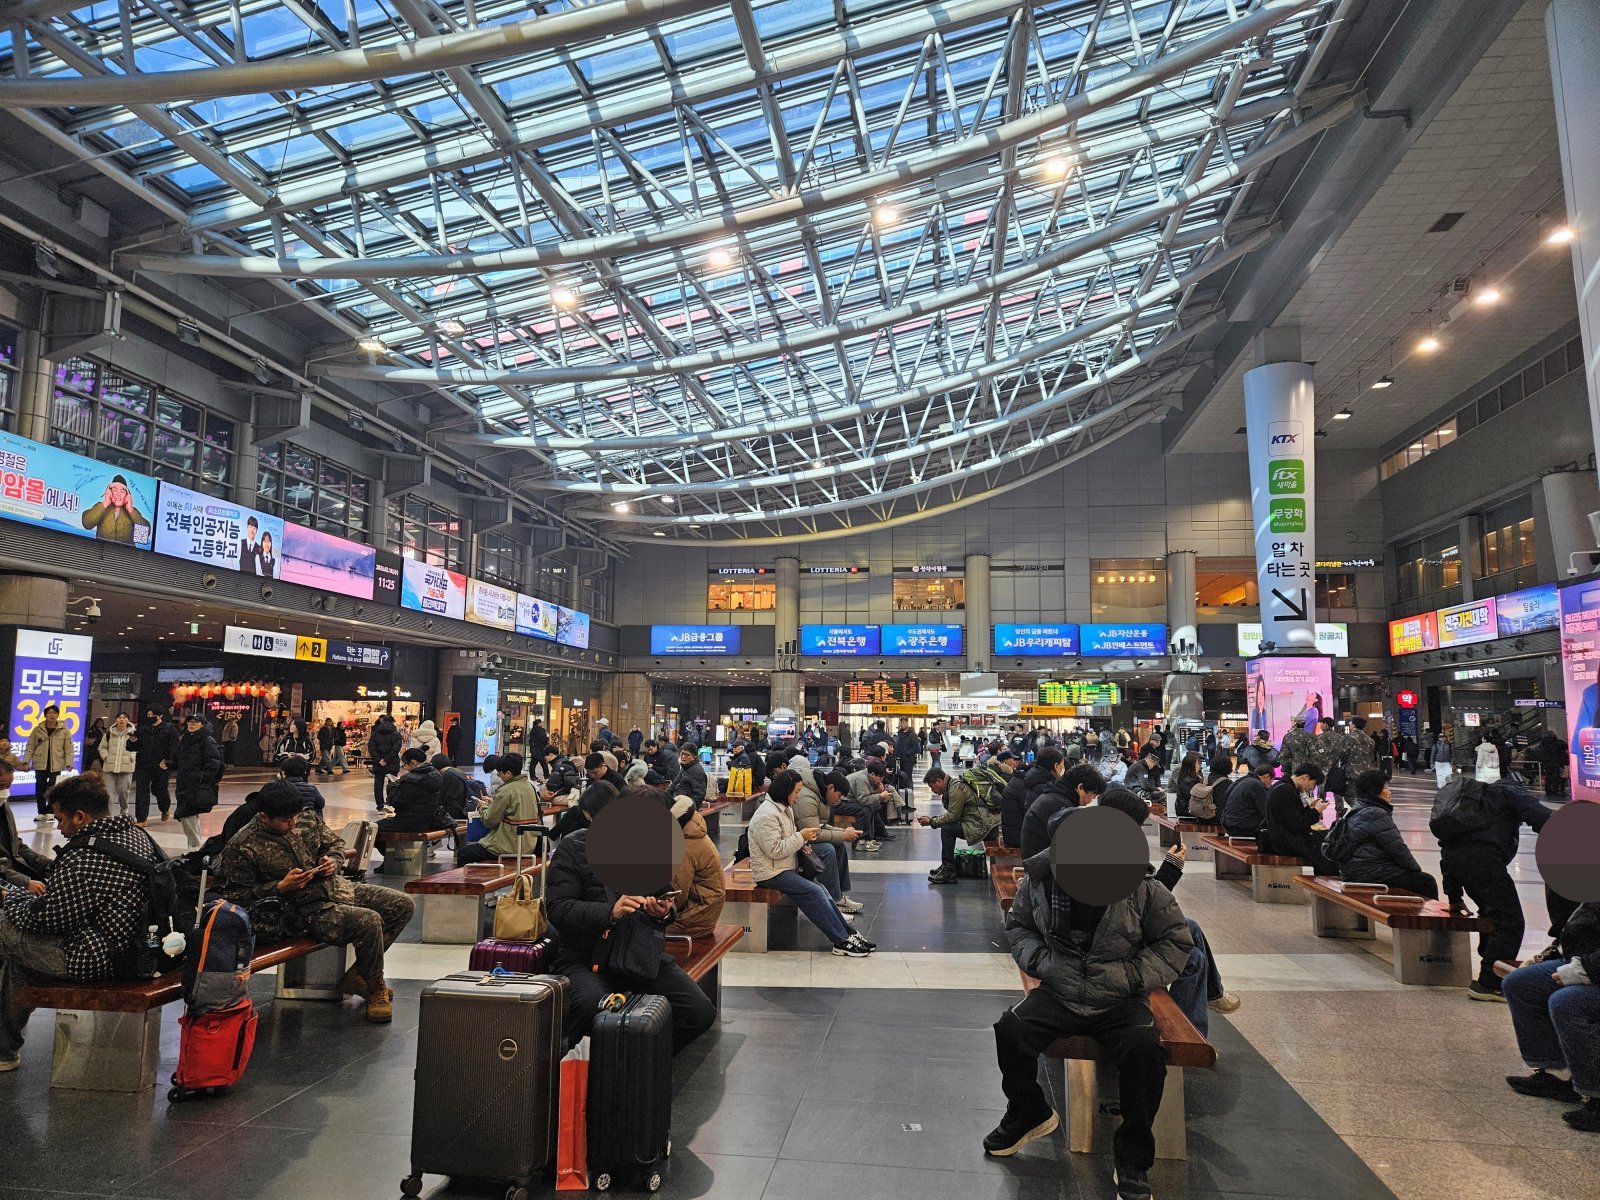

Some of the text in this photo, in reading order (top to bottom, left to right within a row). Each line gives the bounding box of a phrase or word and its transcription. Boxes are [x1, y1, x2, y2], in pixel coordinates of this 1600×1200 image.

[1271, 433, 1301, 444] KTX
[1276, 480, 1297, 489] 새마을
[0, 469, 80, 512] 암몰에서!
[1273, 508, 1303, 519] 무궁화
[165, 512, 240, 540] 전북인공지능
[189, 538, 238, 559] 고등학교
[1268, 562, 1311, 578] 타는 곳
[1444, 607, 1489, 632] 전주기전대학
[678, 632, 723, 642] JB금융그룹
[1106, 629, 1148, 638] JB자산운용
[1318, 631, 1343, 641] 팔꿈치
[275, 638, 288, 648] 화장실
[827, 636, 866, 647] 전북은행
[907, 636, 947, 647] 광주은행
[1013, 637, 1071, 648] JB우리캐피탈
[1101, 640, 1155, 650] JB인베스트먼트
[313, 644, 320, 656] 2
[346, 646, 356, 656] 타는
[19, 669, 83, 697] 모두탑
[1402, 693, 1412, 705] 약
[14, 698, 81, 738] 35
[1467, 713, 1478, 724] 약
[1268, 882, 1291, 890] KORAIL
[1419, 954, 1453, 965] KORAIL
